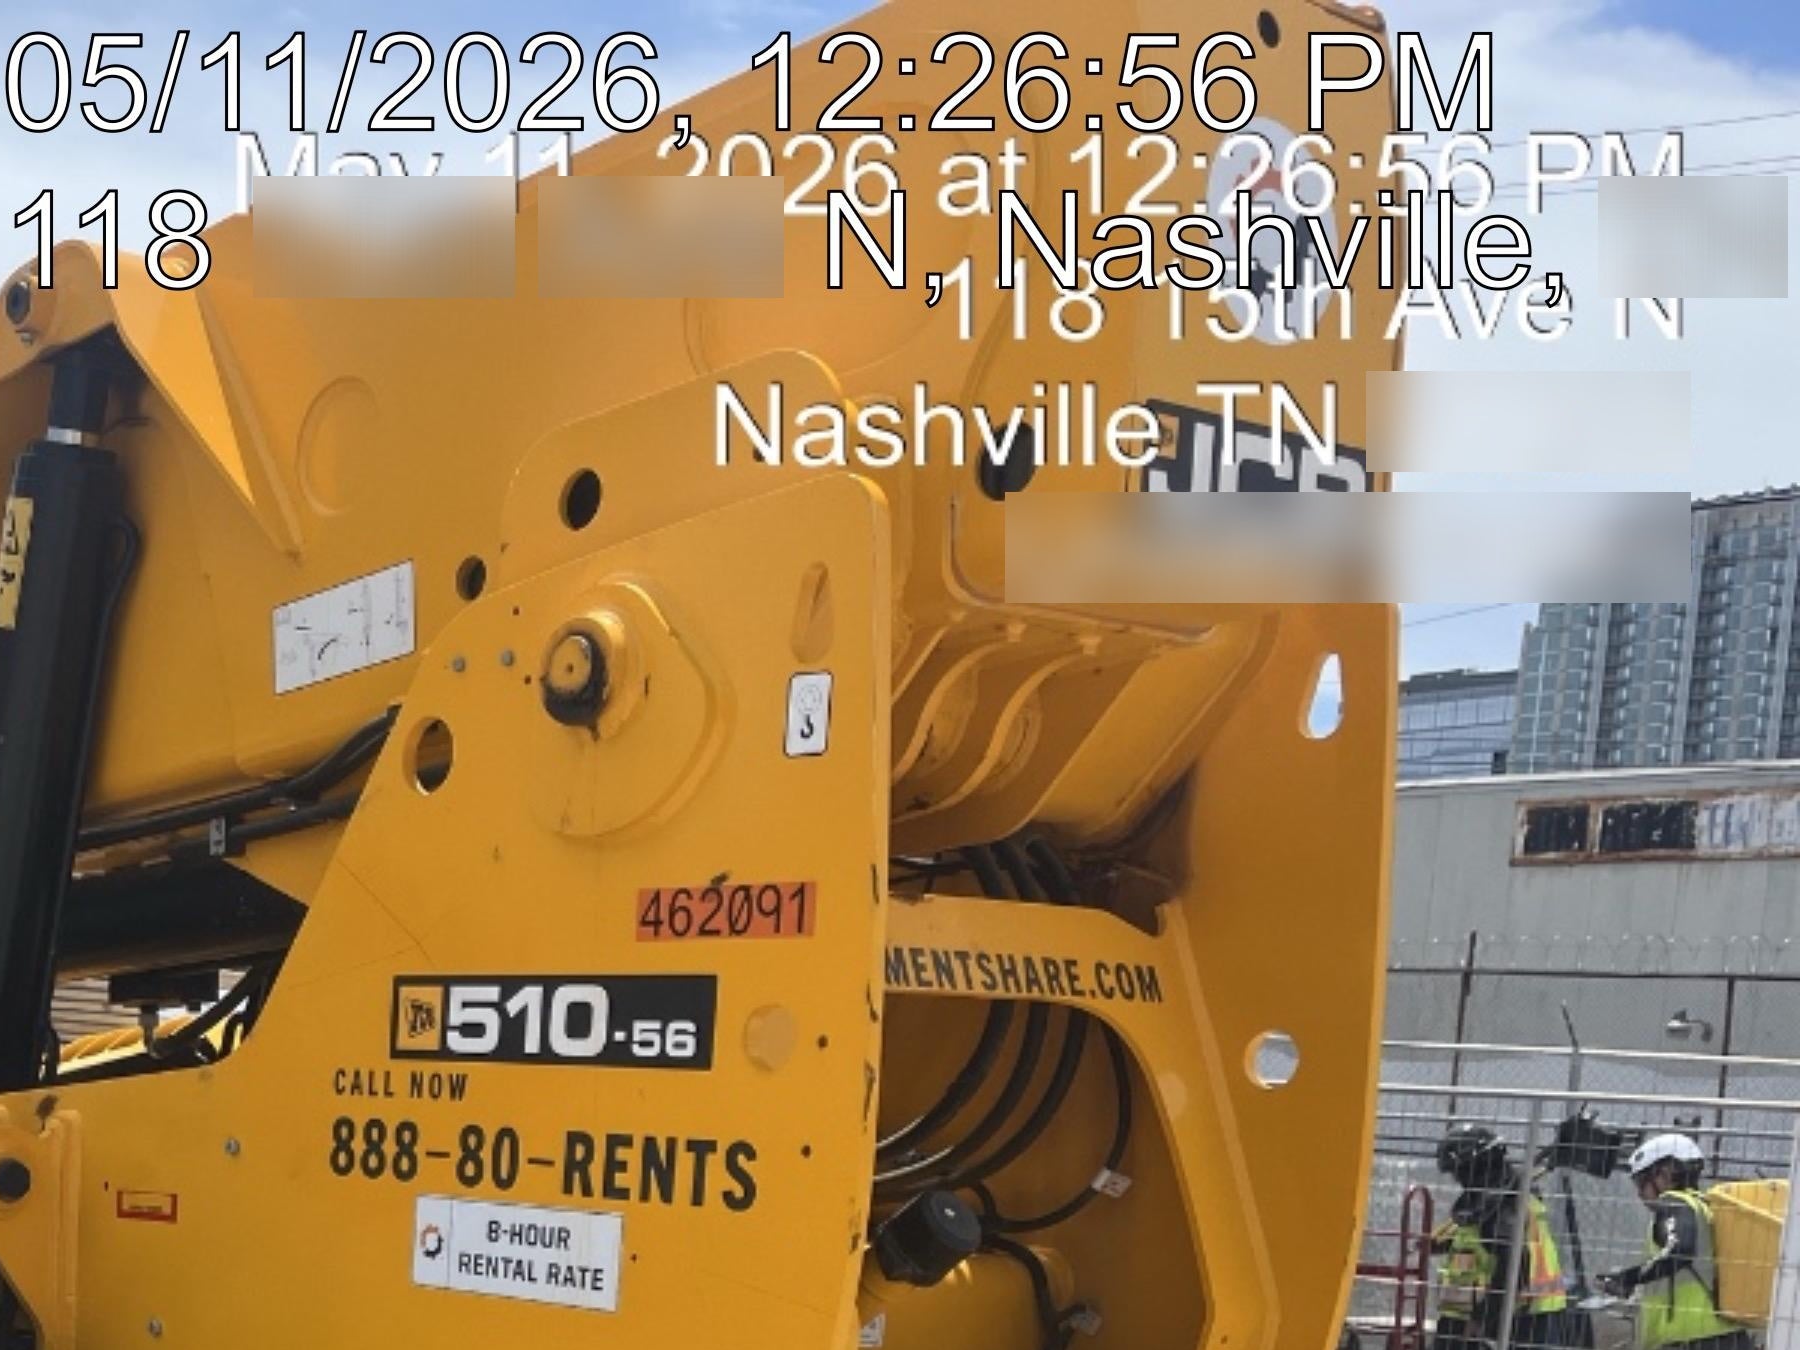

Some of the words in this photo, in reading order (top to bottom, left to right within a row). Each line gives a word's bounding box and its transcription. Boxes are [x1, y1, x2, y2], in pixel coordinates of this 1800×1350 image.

[640, 882, 808, 938] 462091
[333, 1068, 395, 1099] CALL
[409, 1072, 468, 1102] NOW
[329, 1116, 758, 1212] 888-80-RENTS
[486, 1219, 572, 1252] 8-HOUR
[457, 1252, 538, 1285] RENTAL
[545, 1263, 605, 1292] RATE
